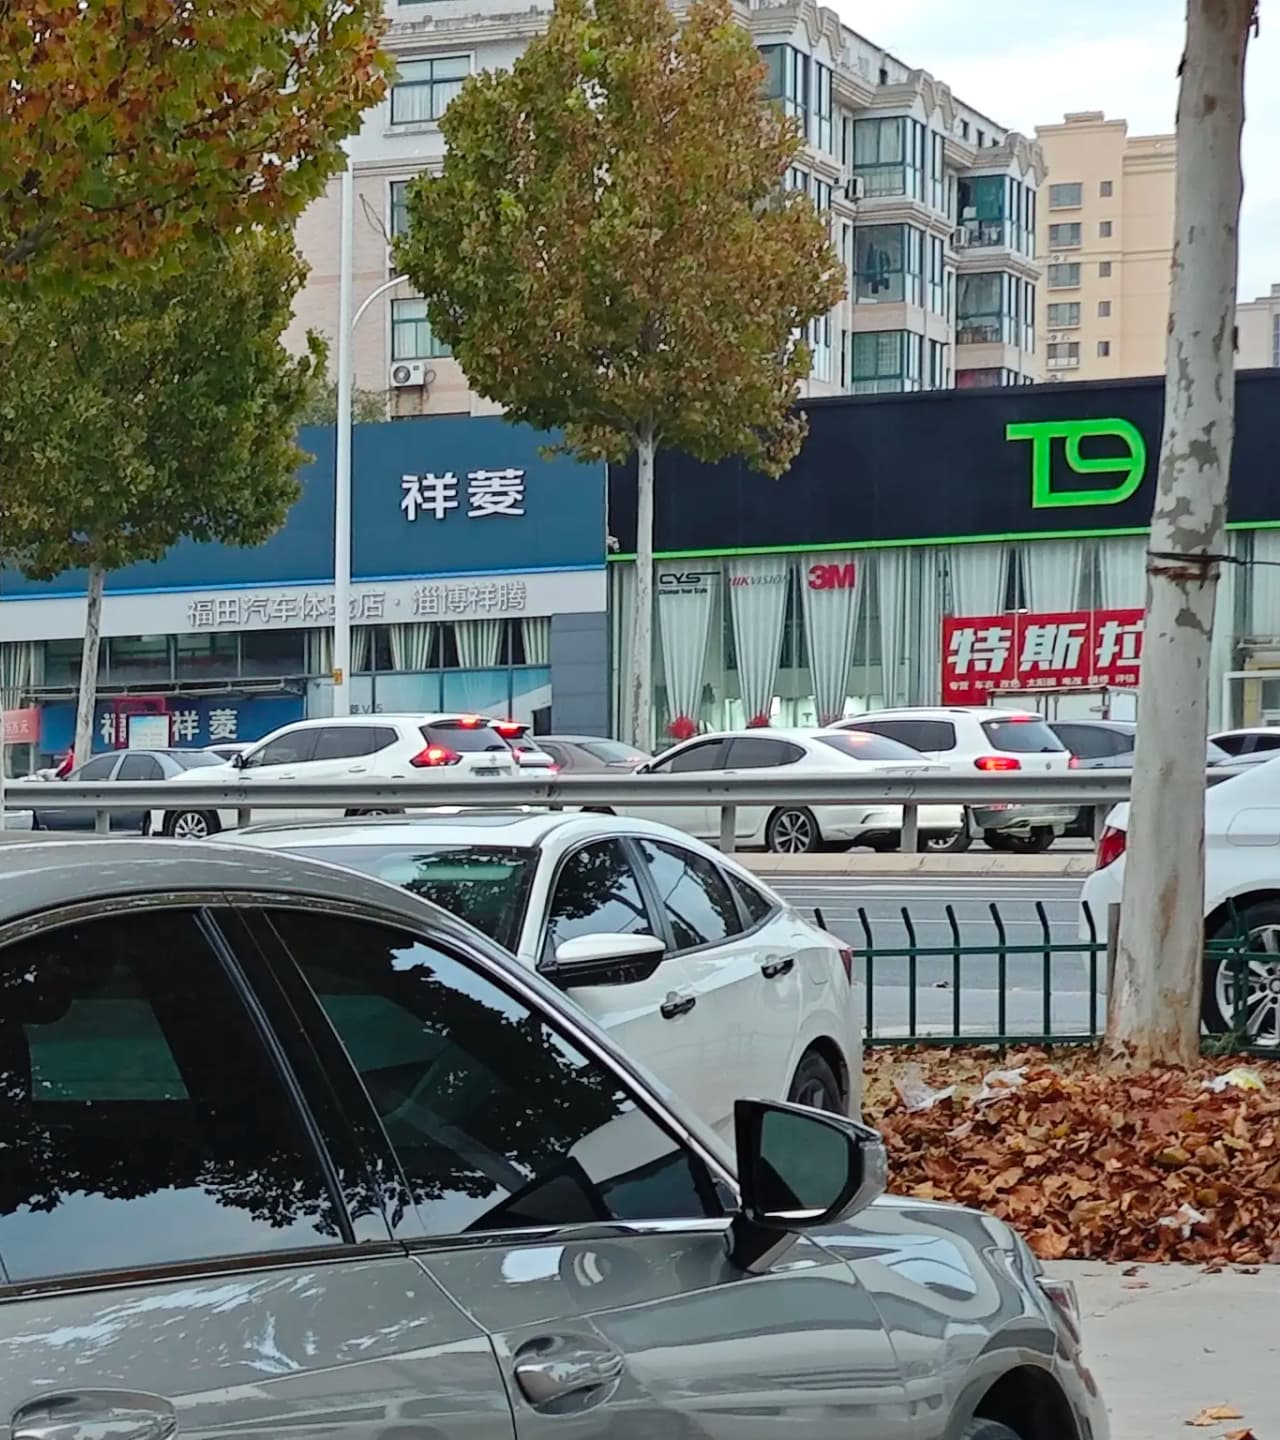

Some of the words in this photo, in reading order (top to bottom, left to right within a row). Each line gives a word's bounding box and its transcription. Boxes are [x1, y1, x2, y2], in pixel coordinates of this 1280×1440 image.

[401, 468, 525, 521] 祥菱
[809, 563, 855, 590] 3M
[947, 620, 1144, 674] 特斯拉
[101, 708, 238, 744] 福祥菱
